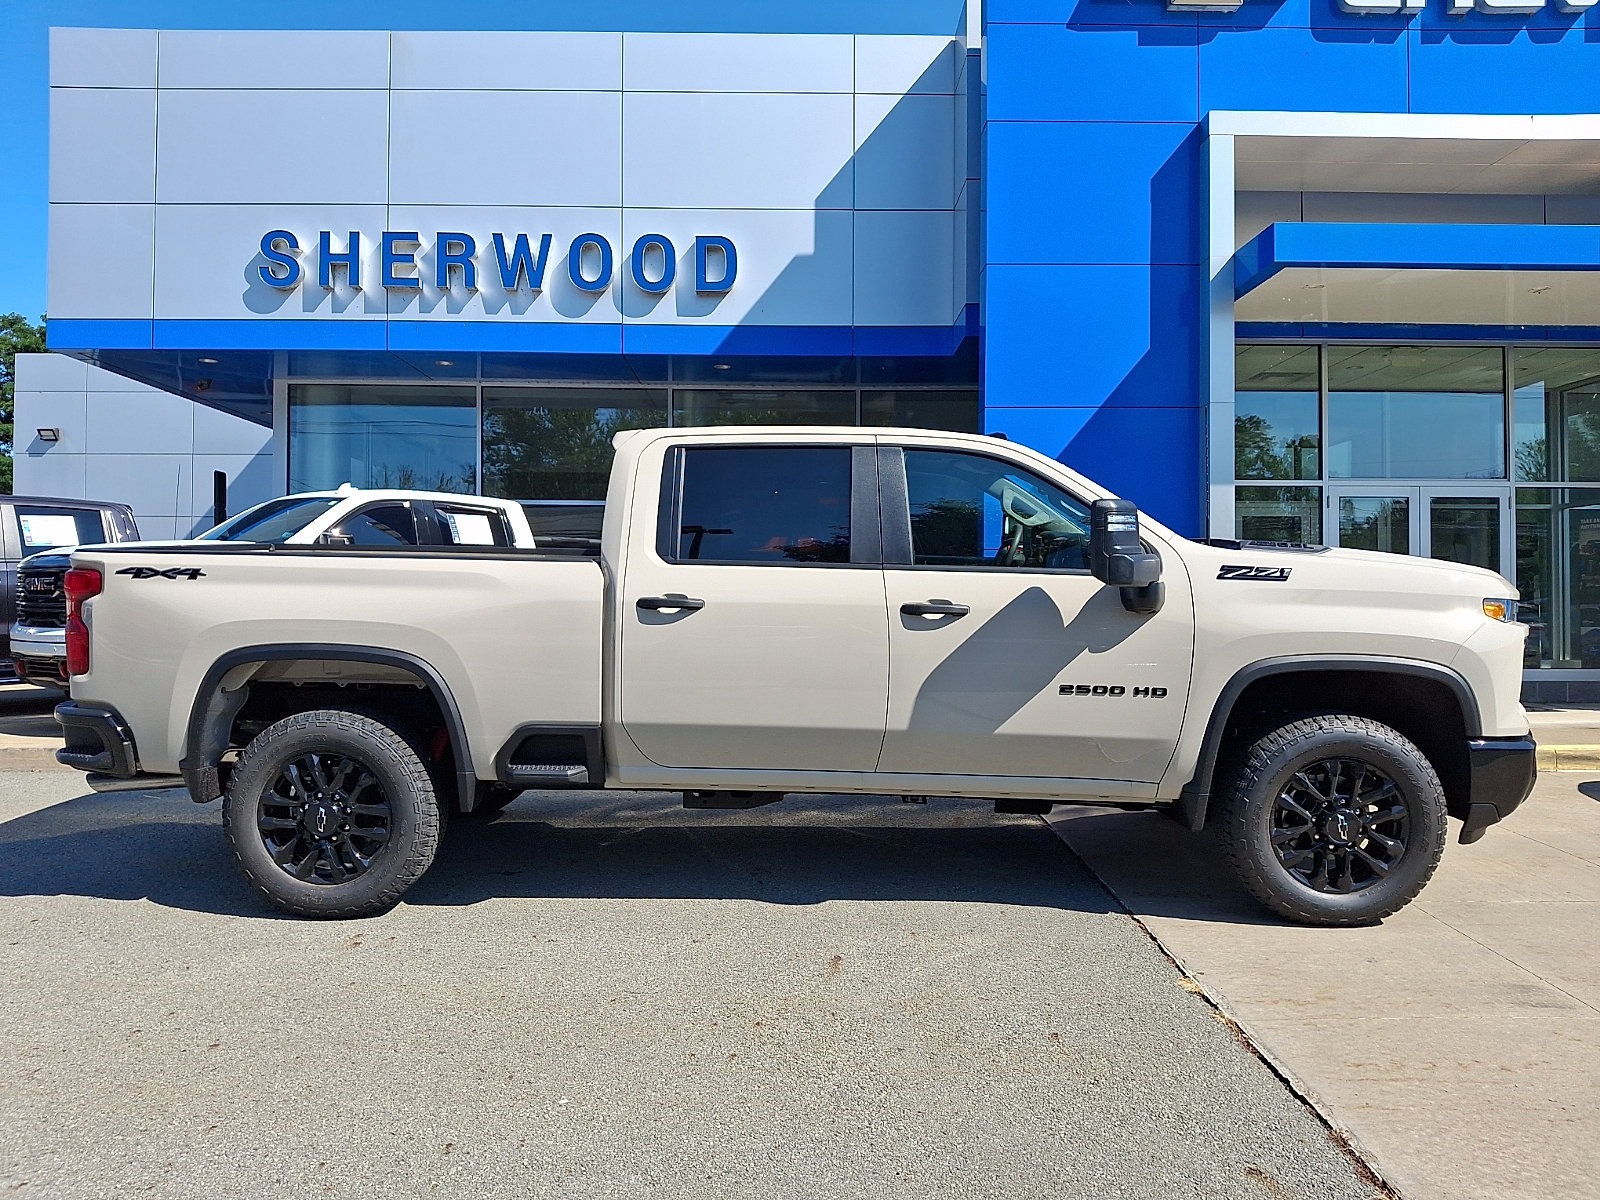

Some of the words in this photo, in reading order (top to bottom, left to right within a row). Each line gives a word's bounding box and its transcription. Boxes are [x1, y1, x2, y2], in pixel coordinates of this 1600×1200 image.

[258, 229, 738, 293] SHERWOOD
[1216, 565, 1293, 581] Z71
[1058, 684, 1126, 697] 2500
[1132, 686, 1168, 698] HD
